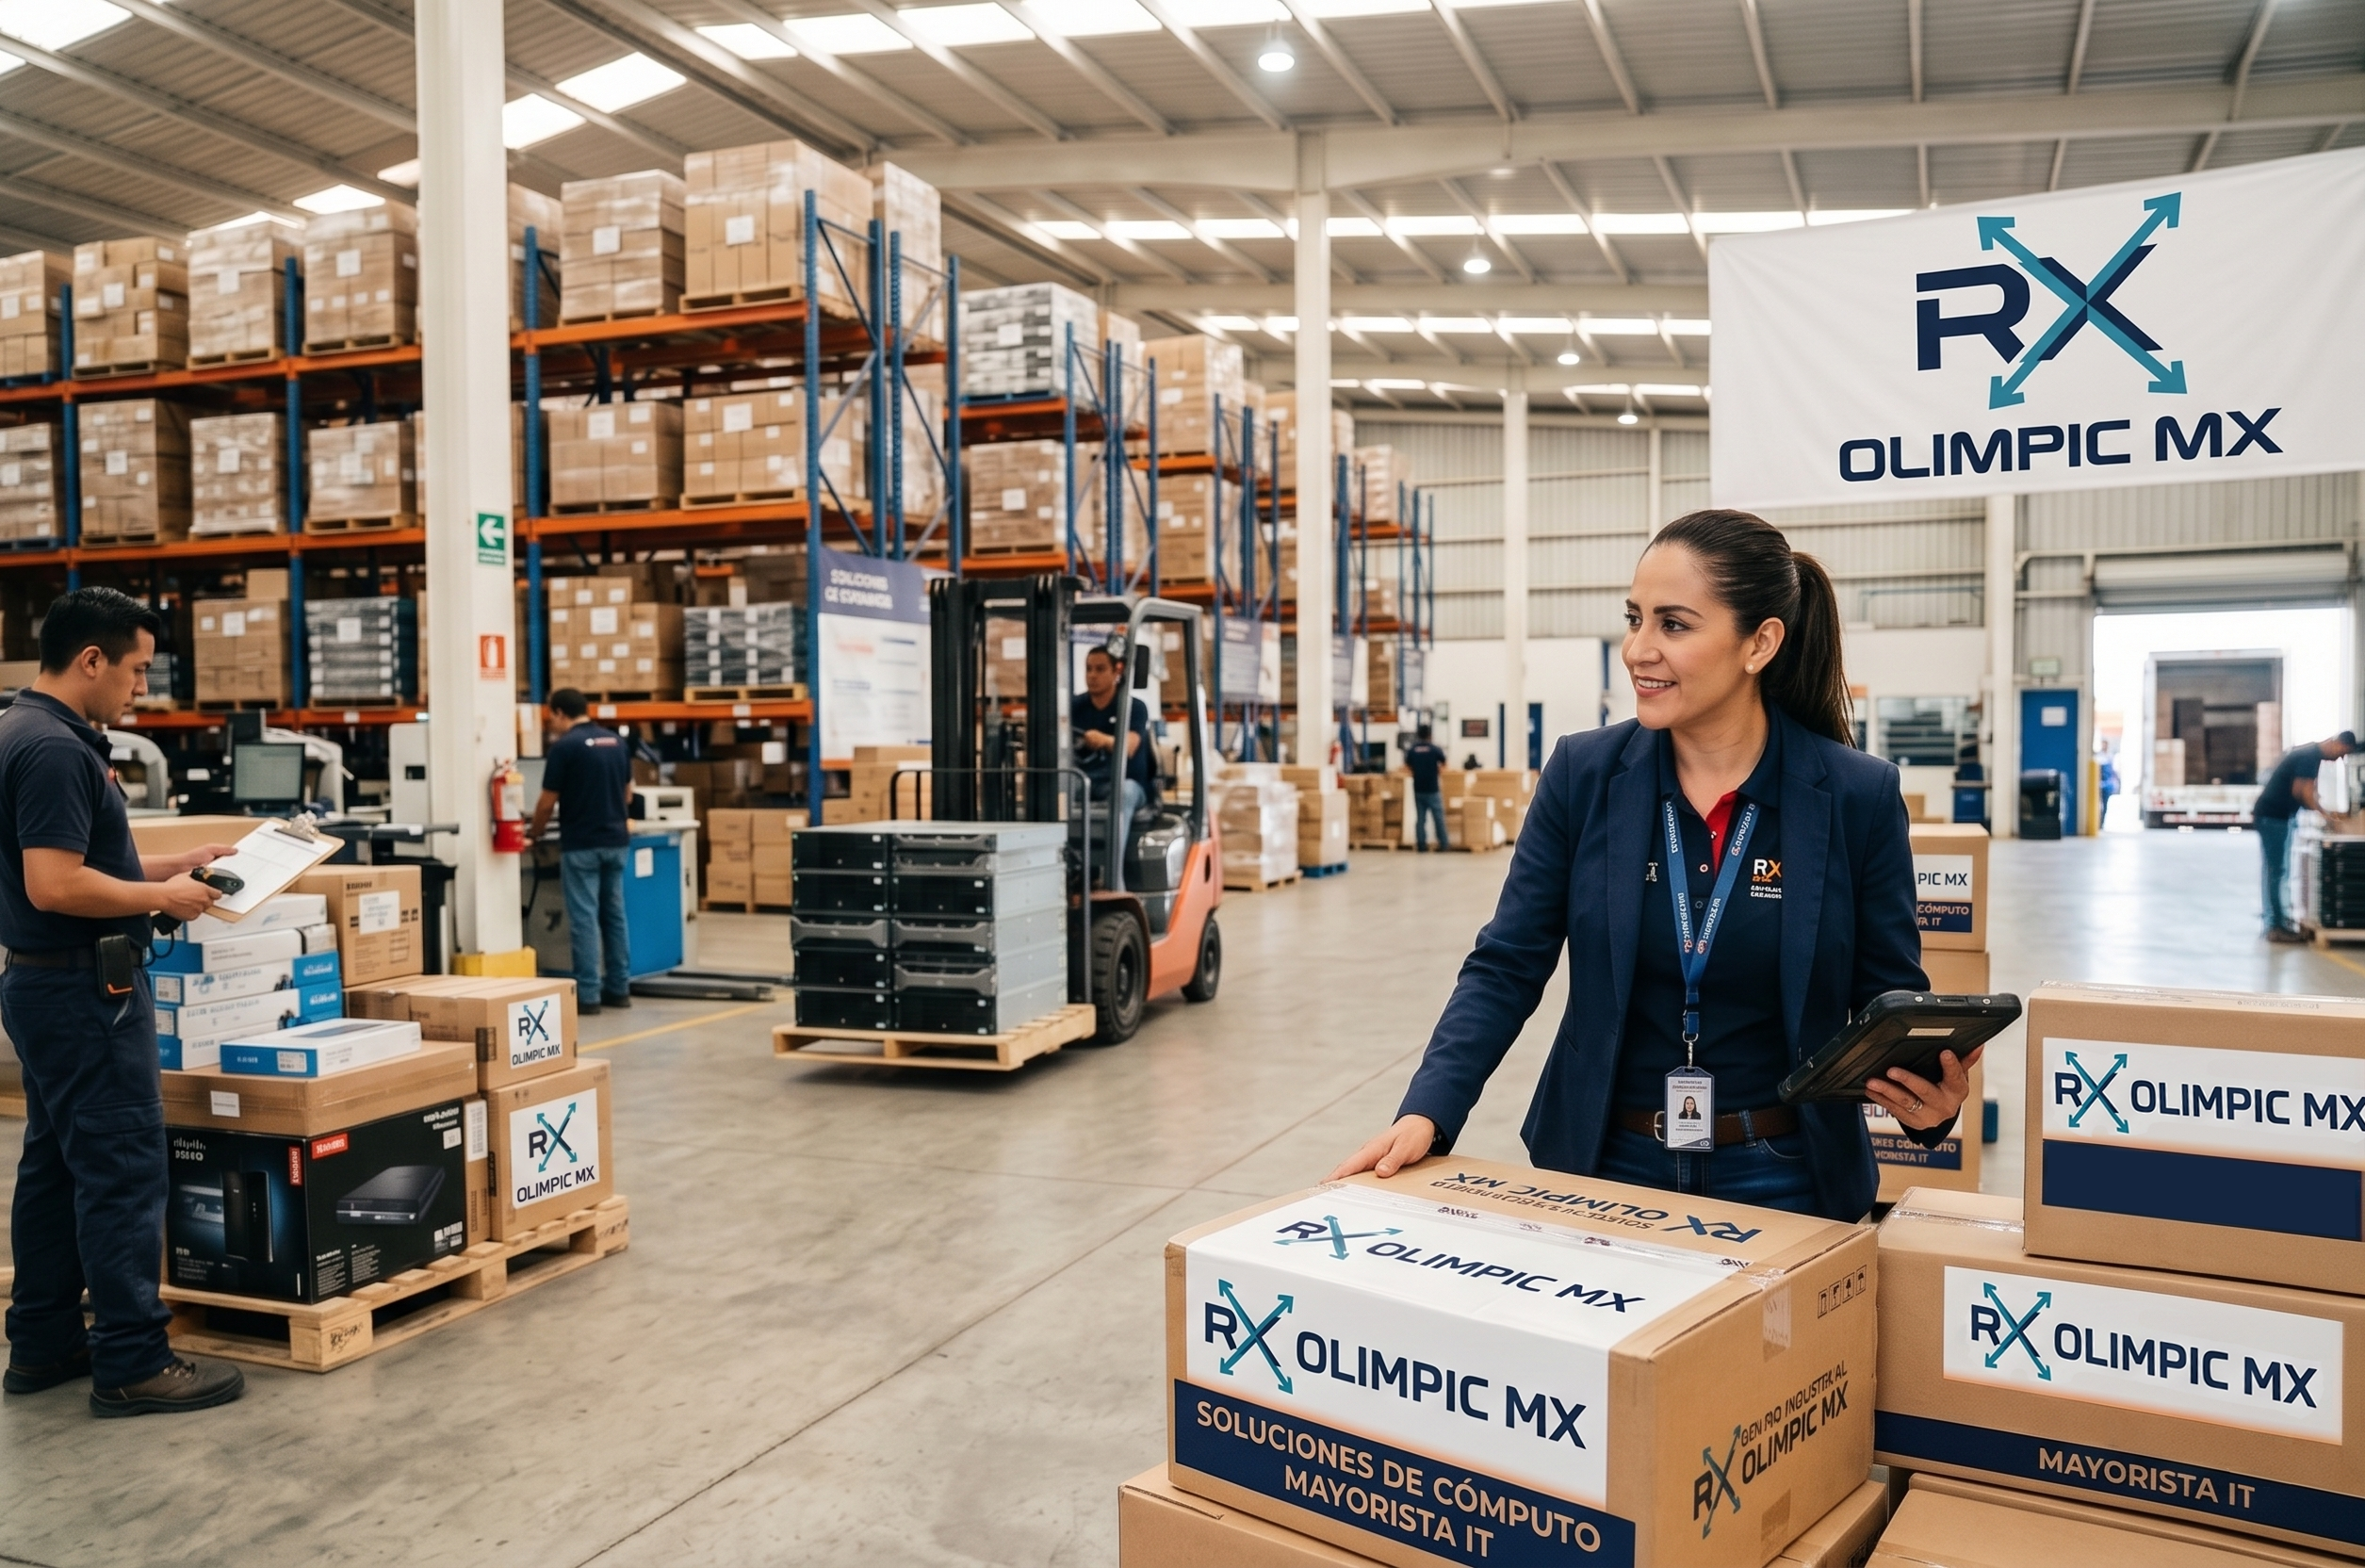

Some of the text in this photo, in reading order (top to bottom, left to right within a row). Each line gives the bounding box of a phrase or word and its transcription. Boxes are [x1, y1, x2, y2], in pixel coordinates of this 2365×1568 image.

[1916, 191, 2187, 410] RX
[1839, 407, 2284, 482] OLIMPIC MX
[1753, 858, 1782, 878] RX
[1945, 873, 1968, 886] MX
[512, 1047, 546, 1066] OLIMPIC
[518, 1000, 549, 1046] RX
[2054, 1051, 2365, 1135] RX OLIMPIC MX
[528, 1102, 578, 1173] RX
[1918, 1153, 1929, 1164] IT
[516, 1165, 595, 1202] OLIMPIC MX
[1443, 1172, 1508, 1188] MX
[1508, 1184, 1670, 1220] OLIMPIC
[1664, 1214, 1763, 1244] RX
[1273, 1215, 1646, 1313] RX OLIMPIC MX
[1204, 1278, 1588, 1450] RX OLIMPIC MX
[1970, 1282, 2318, 1409] RX OLIMPIC MX
[1196, 1400, 1602, 1554] SOLUCIONES DE CÓMPUTO
[1693, 1380, 1849, 1541] RX OLIMPIC MX
[2038, 1446, 2256, 1509] MAYORISTA IT
[1284, 1464, 1494, 1559] MAYORISTA IT
